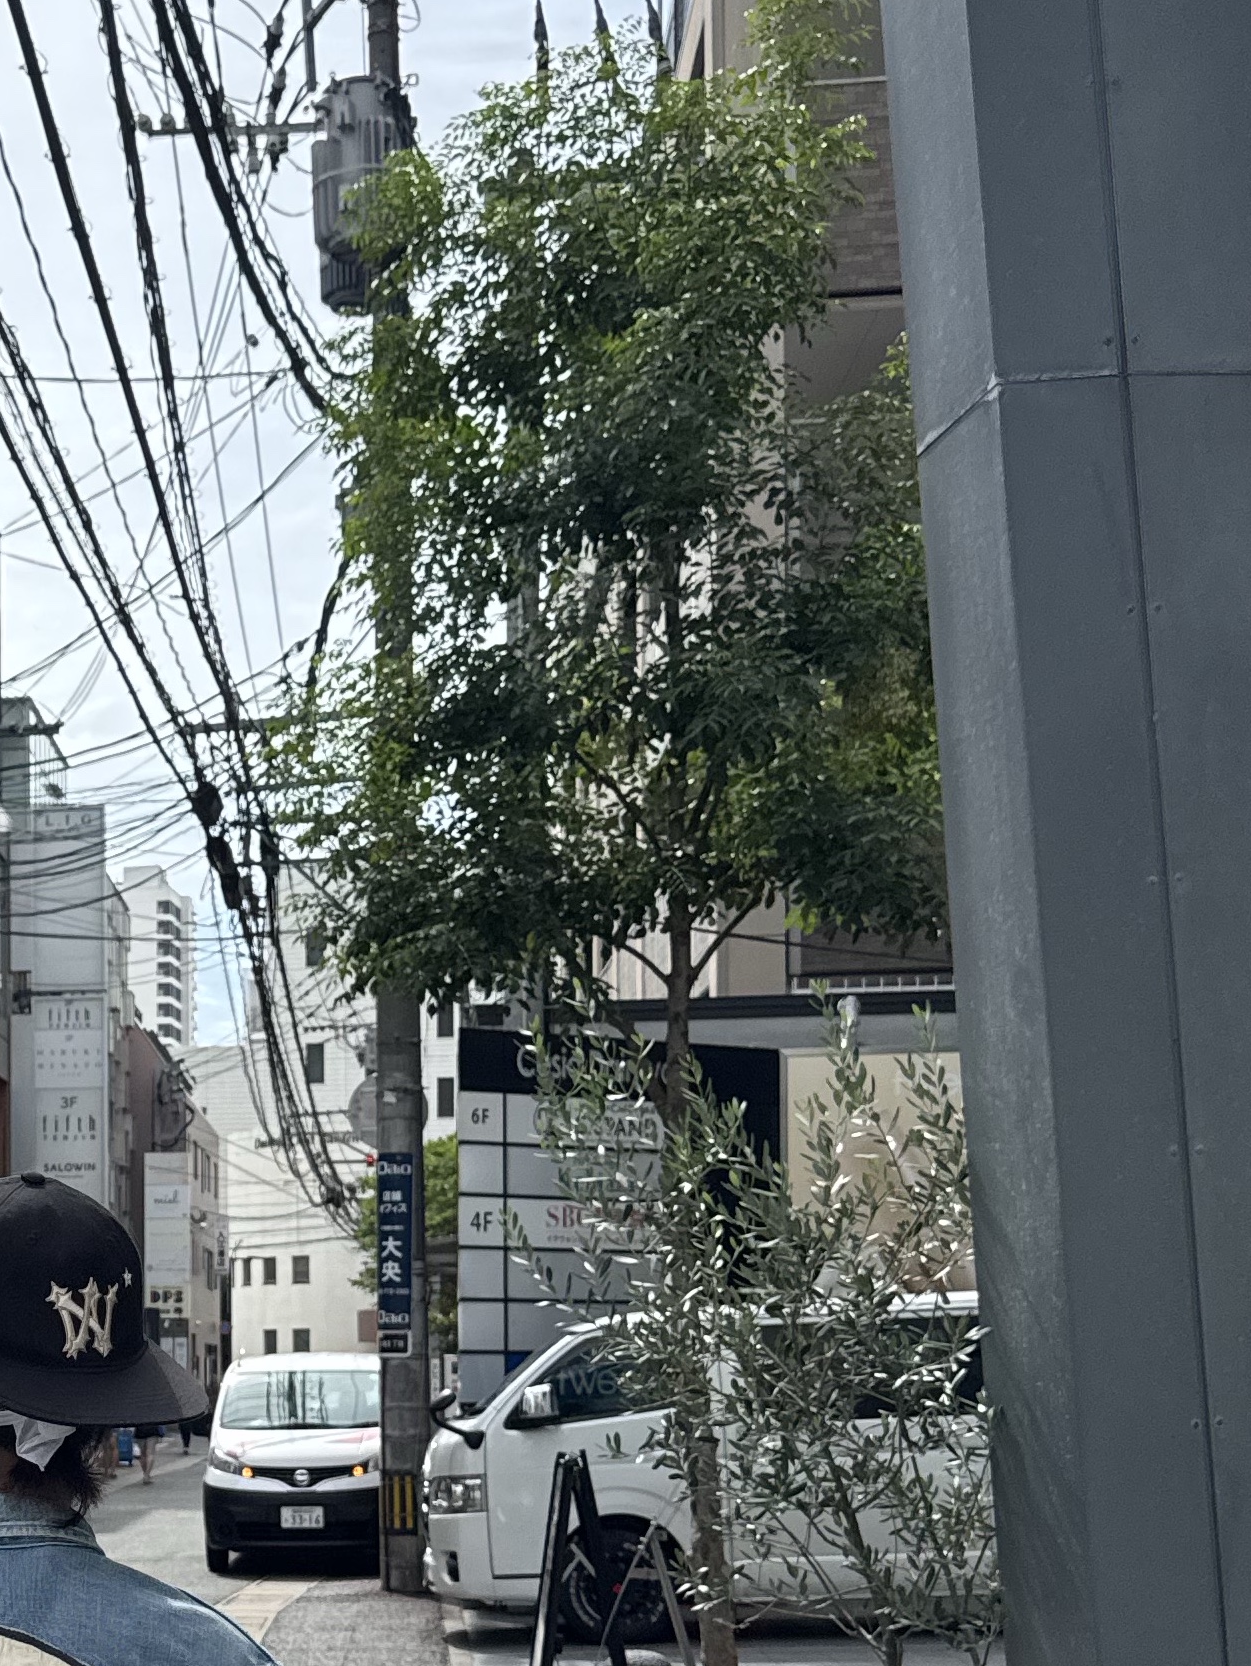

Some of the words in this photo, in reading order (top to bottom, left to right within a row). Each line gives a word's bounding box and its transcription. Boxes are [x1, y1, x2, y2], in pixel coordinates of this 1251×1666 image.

[60, 1096, 79, 1109] 3F
[471, 1108, 490, 1124] 6F
[470, 1211, 493, 1232] 4F
[381, 1235, 403, 1283] 大央
